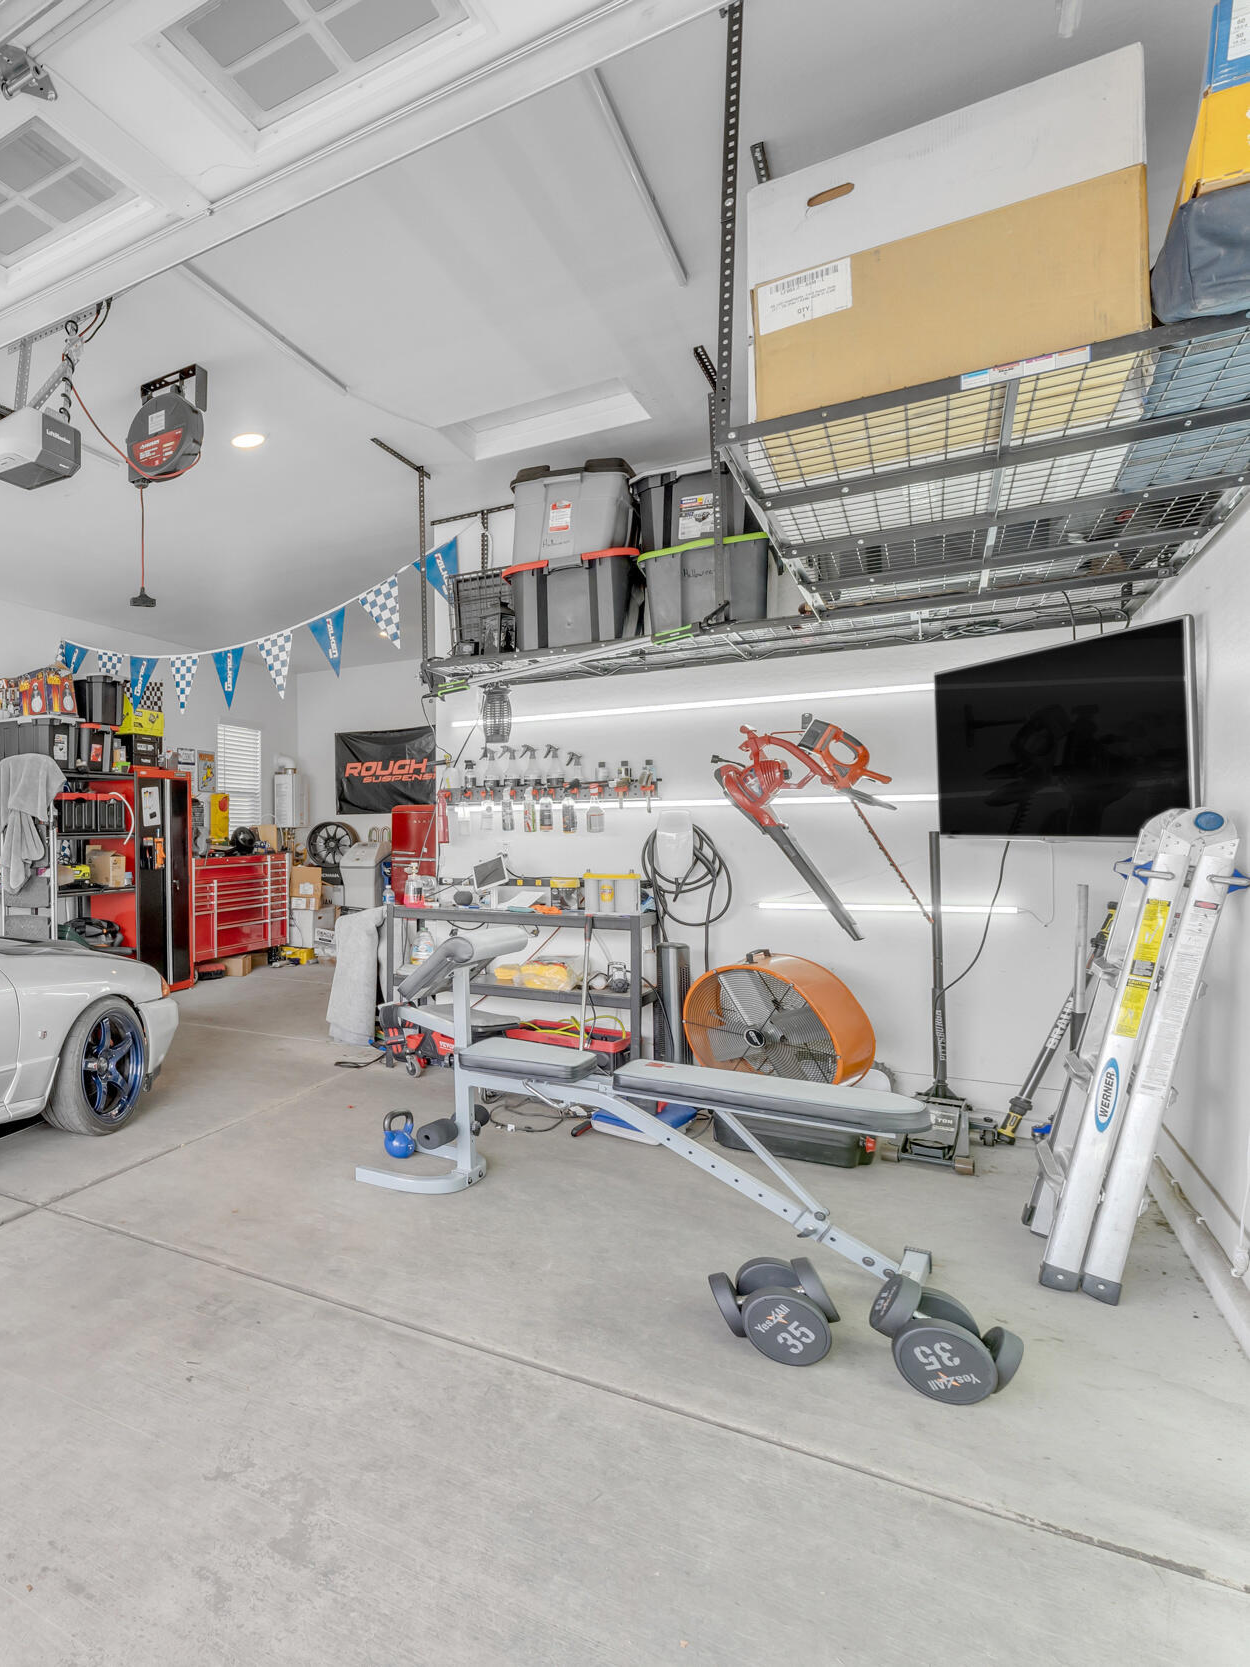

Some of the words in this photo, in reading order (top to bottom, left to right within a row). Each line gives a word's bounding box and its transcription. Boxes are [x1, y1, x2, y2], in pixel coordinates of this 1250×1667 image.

[345, 758, 428, 777] ROUGH
[362, 772, 436, 783] SUSPENSI
[1099, 1071, 1115, 1117] WERNER
[754, 1303, 791, 1334] Yes4All
[776, 1321, 817, 1354] 35
[913, 1342, 961, 1371] 35
[927, 1372, 981, 1392] Yes4All
